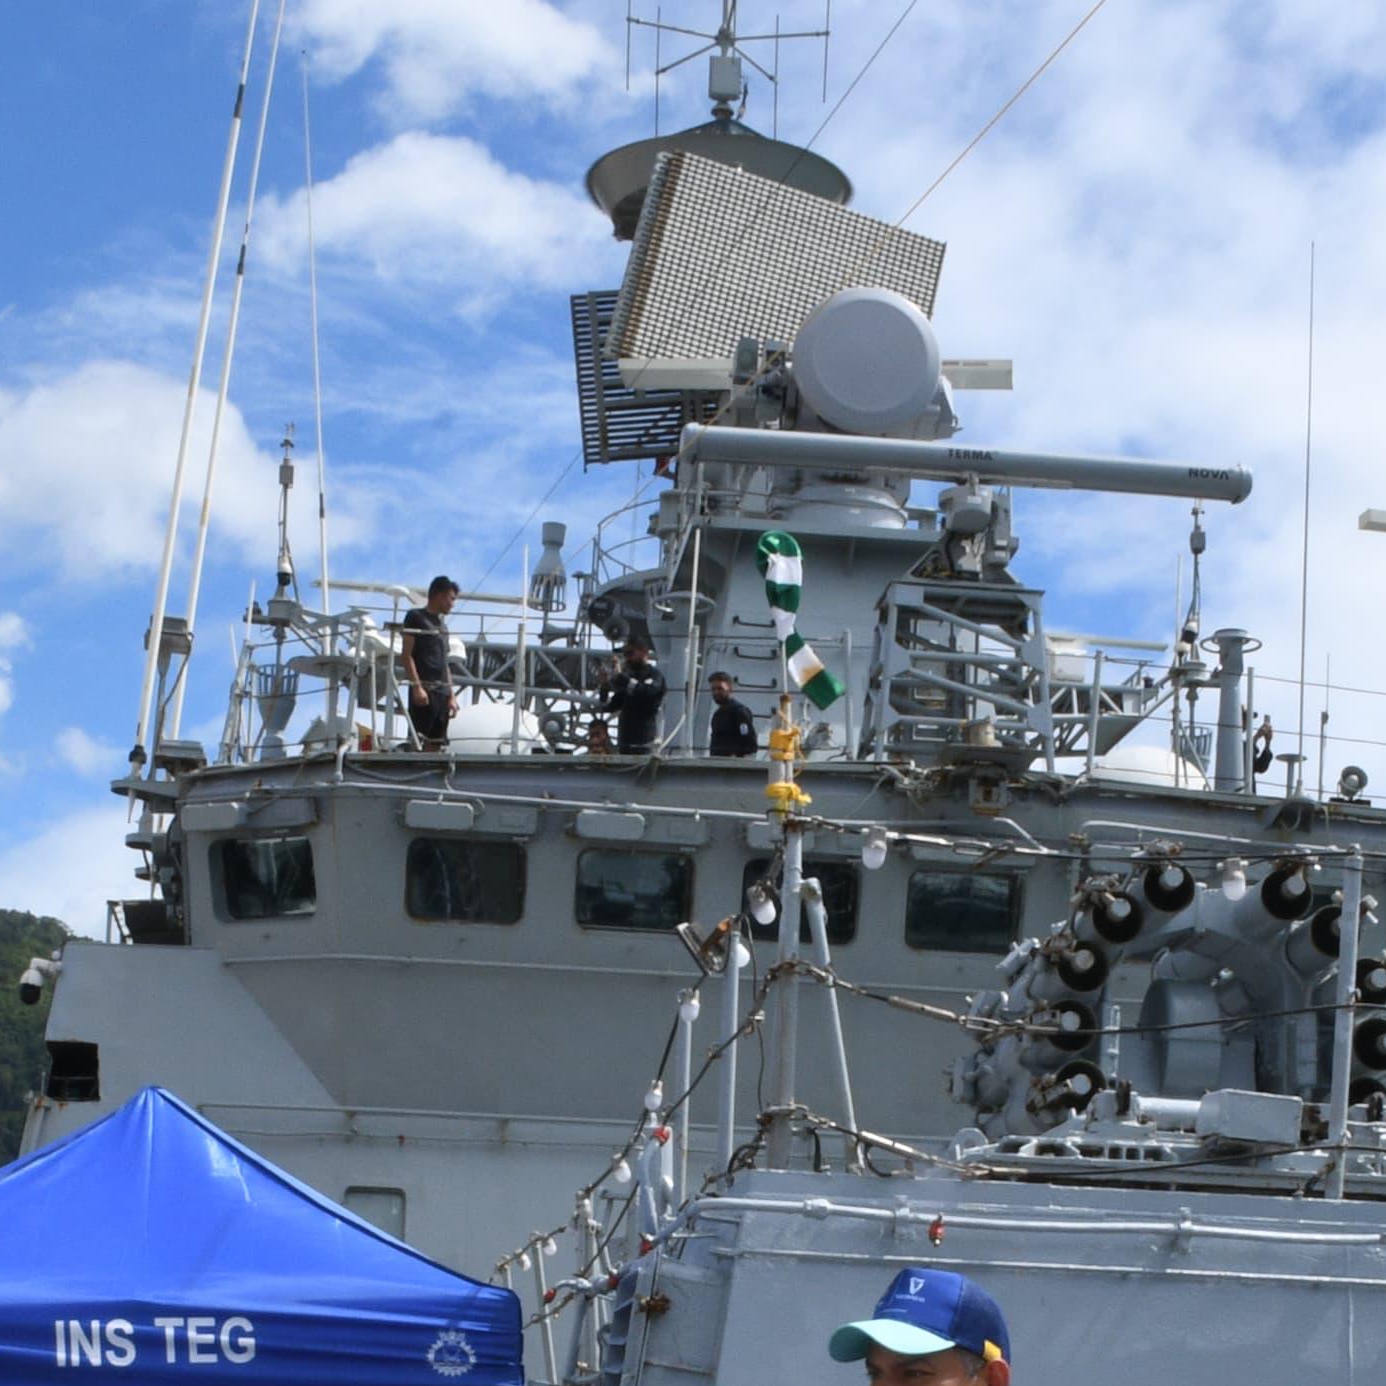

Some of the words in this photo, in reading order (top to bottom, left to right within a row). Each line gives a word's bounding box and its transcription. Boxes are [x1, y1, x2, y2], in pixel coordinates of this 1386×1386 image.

[948, 447, 993, 461] TERMA
[1189, 467, 1230, 480] NOVA
[55, 1318, 136, 1367] INS
[154, 1317, 256, 1364] TEG
